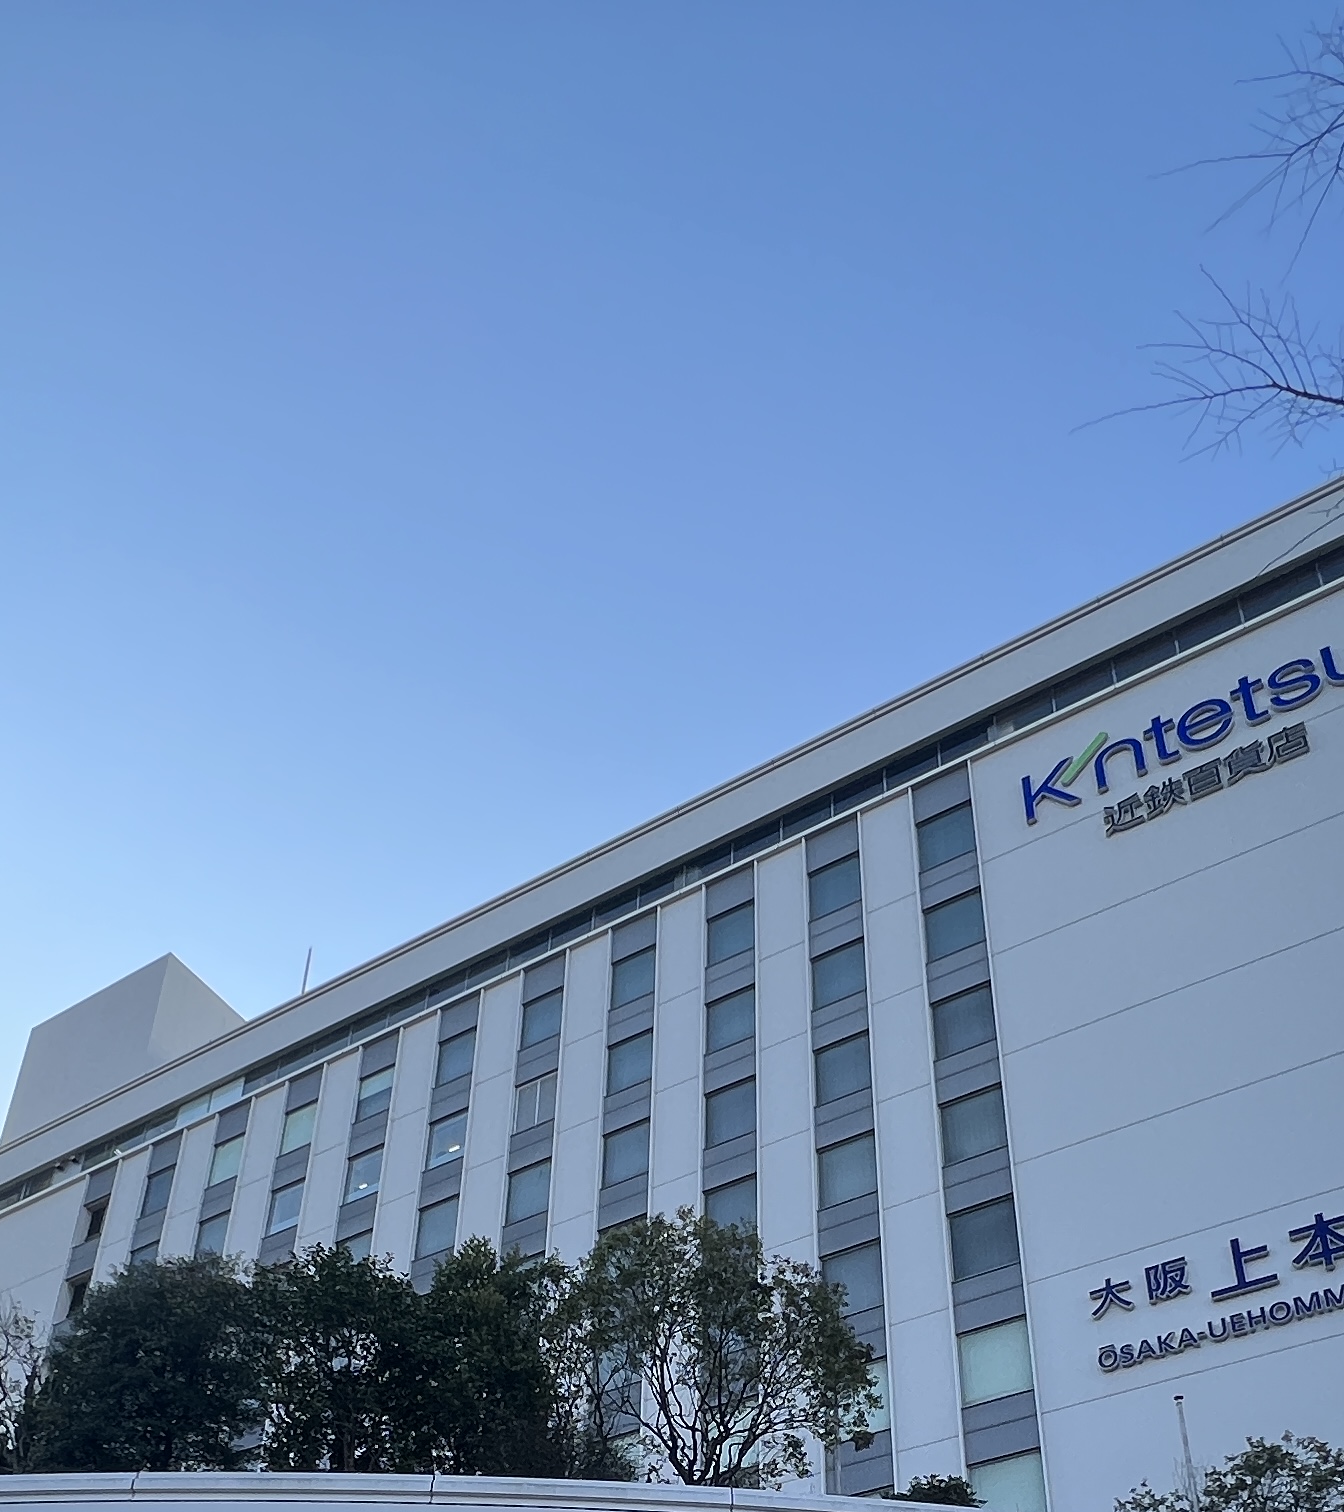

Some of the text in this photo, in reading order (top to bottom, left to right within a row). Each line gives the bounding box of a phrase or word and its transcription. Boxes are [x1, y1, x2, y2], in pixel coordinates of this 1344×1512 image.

[1103, 720, 1311, 838] 近鉄百貨店
